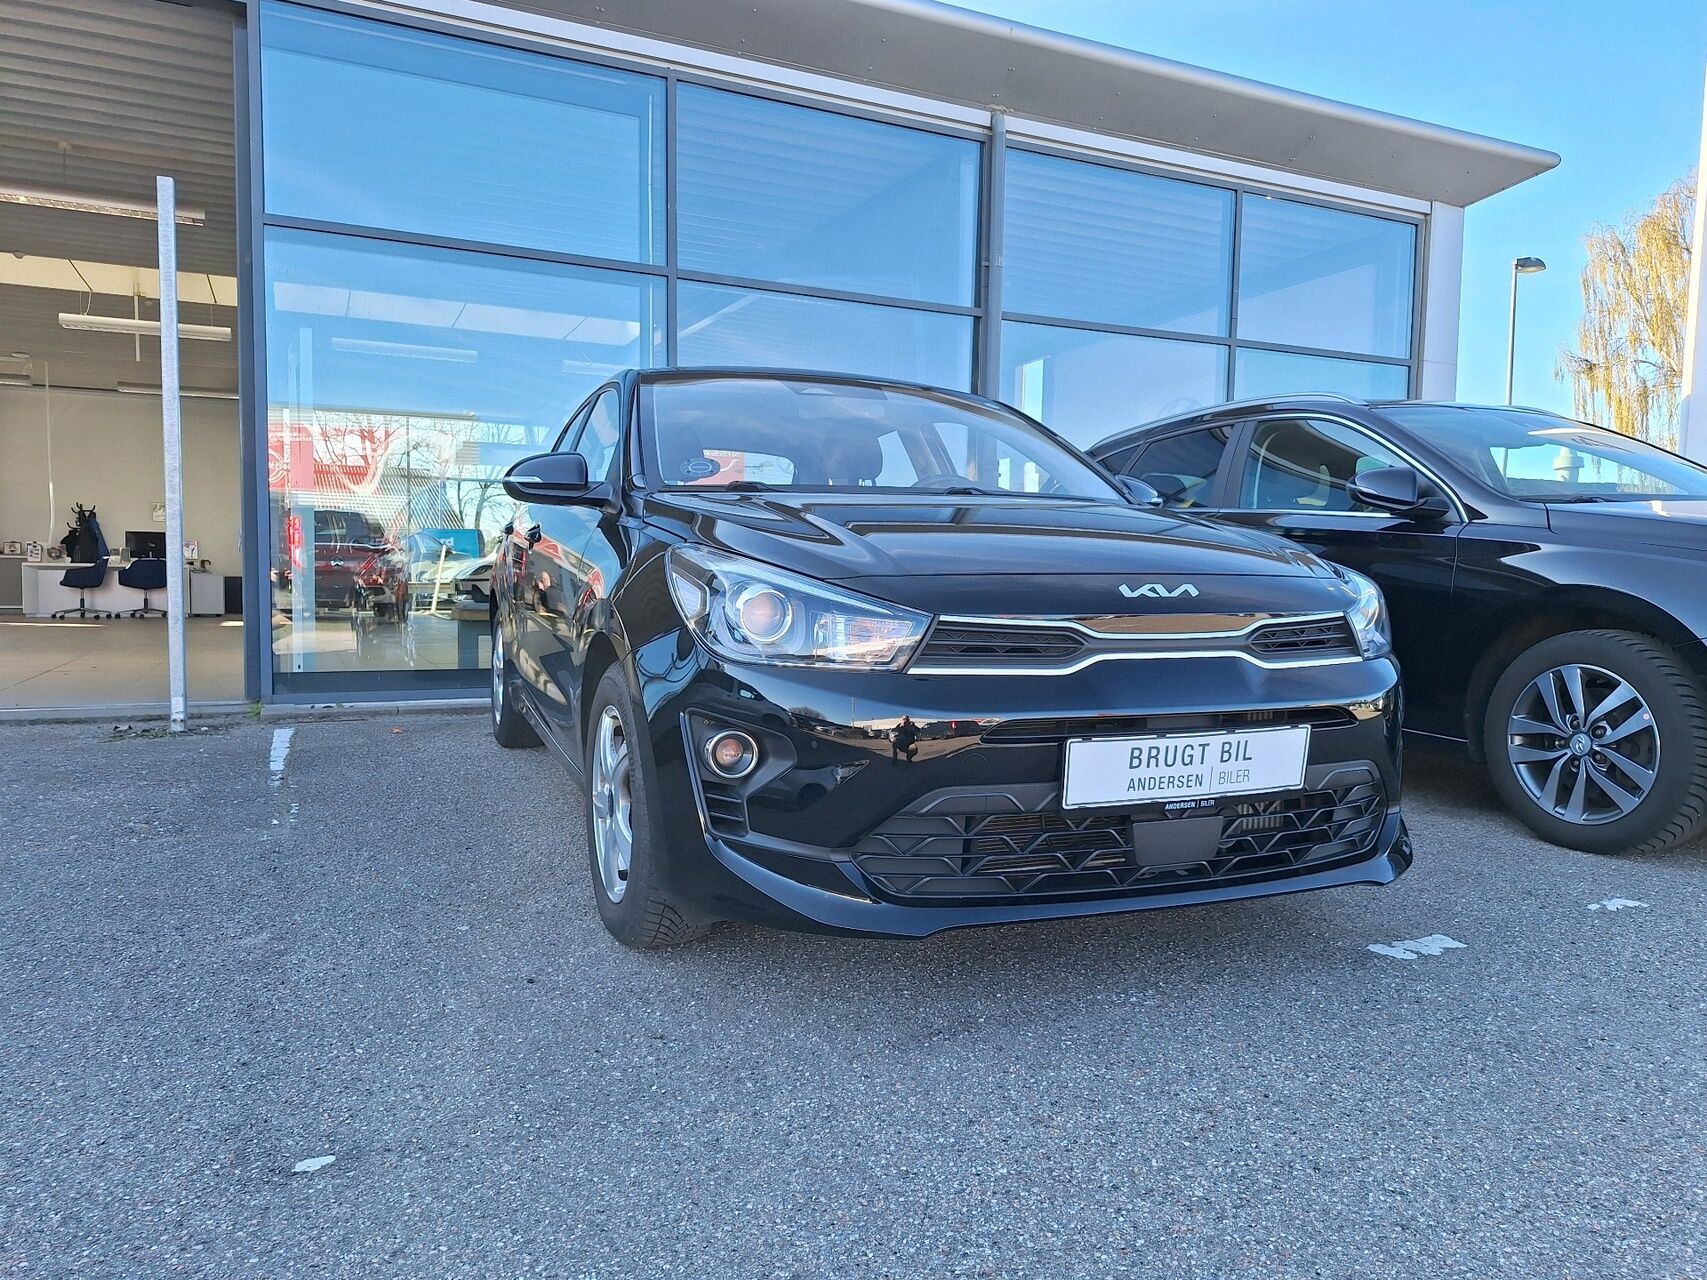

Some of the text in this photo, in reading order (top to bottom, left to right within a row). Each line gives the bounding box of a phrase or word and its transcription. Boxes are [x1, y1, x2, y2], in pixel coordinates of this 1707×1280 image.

[1118, 583, 1200, 598] KIA
[1128, 740, 1253, 769] BRUGT BIL
[1127, 769, 1250, 792] ANDERSEN BILER
[1164, 799, 1215, 810] ANDERSEN BILER
